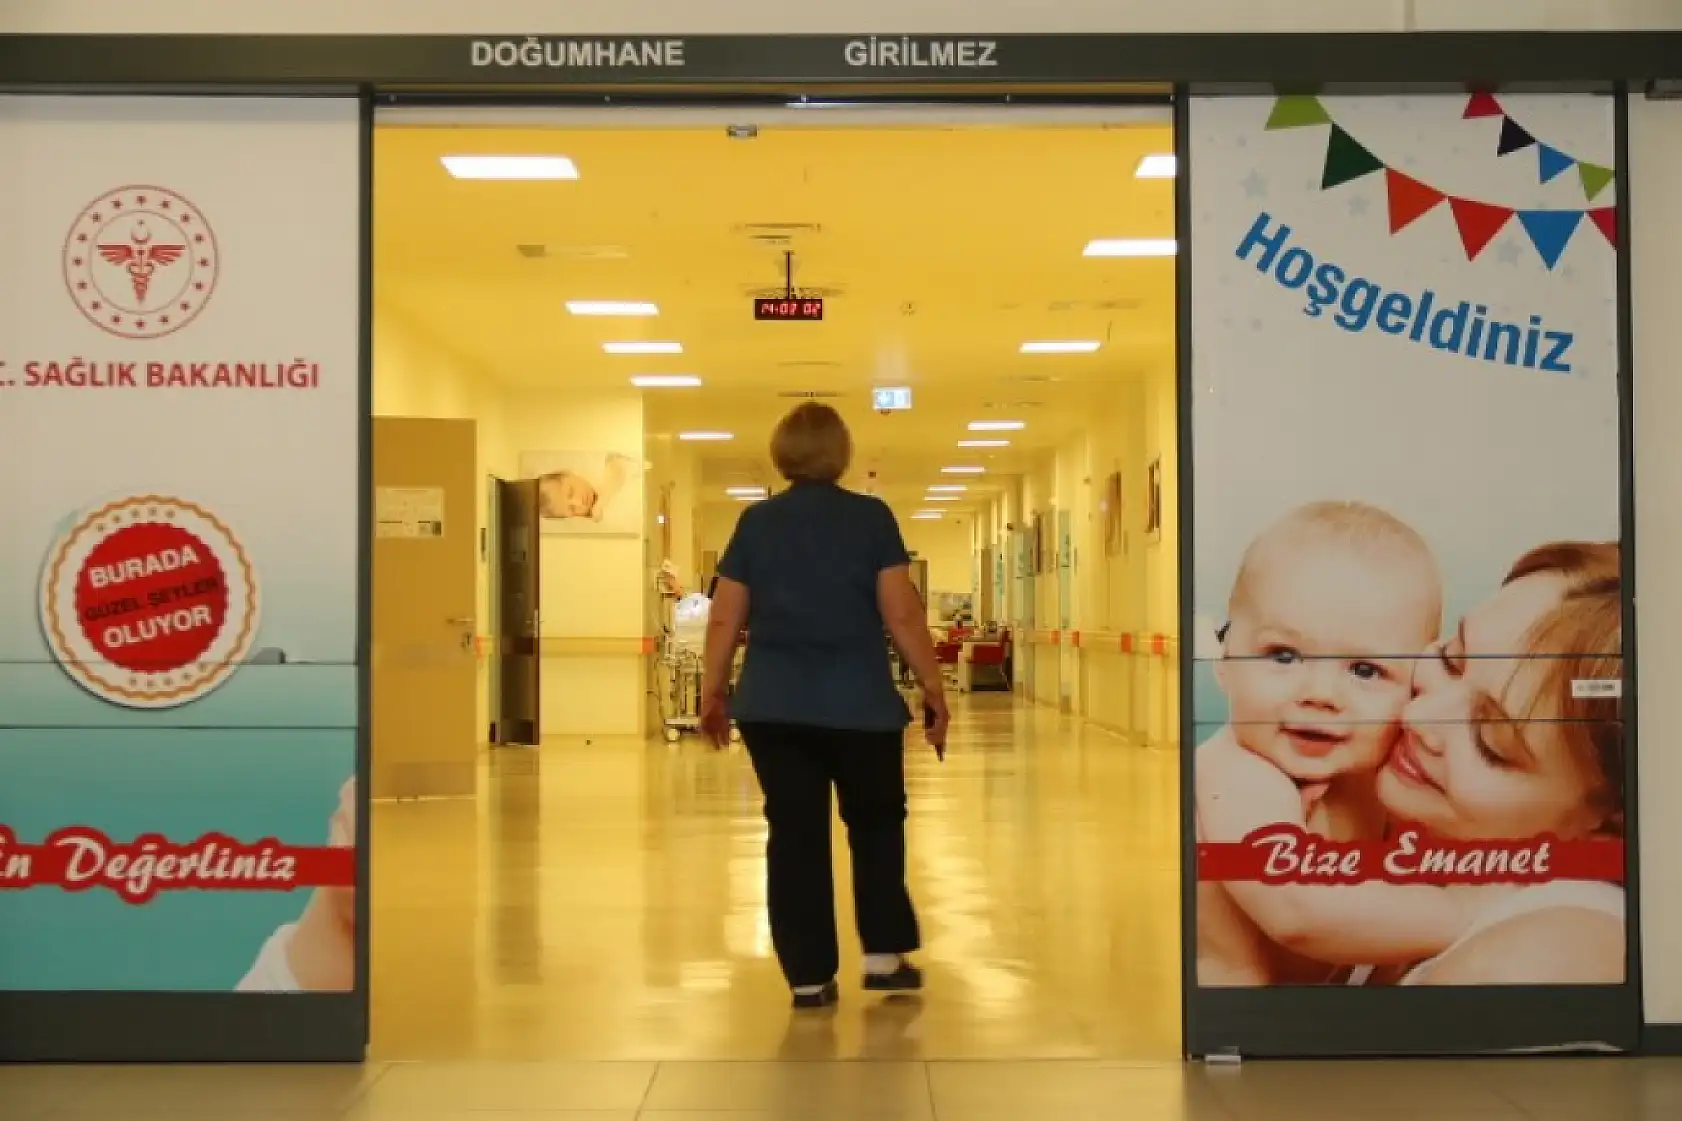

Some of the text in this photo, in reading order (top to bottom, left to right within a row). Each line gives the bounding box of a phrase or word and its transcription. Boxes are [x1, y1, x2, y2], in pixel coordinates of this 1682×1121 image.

[471, 36, 685, 67] DOĞUMHANE
[844, 35, 998, 67] GİRİLMEZ
[1234, 211, 1574, 373] Hoşgeldiniz
[23, 356, 138, 387] SAĞLIK
[146, 357, 320, 389] BAKANLIĞI
[88, 544, 201, 588] BURADA
[103, 604, 213, 648] OLUYOR
[0, 835, 297, 894] n Değerliniz
[1251, 831, 1550, 876] Bize Emanet
